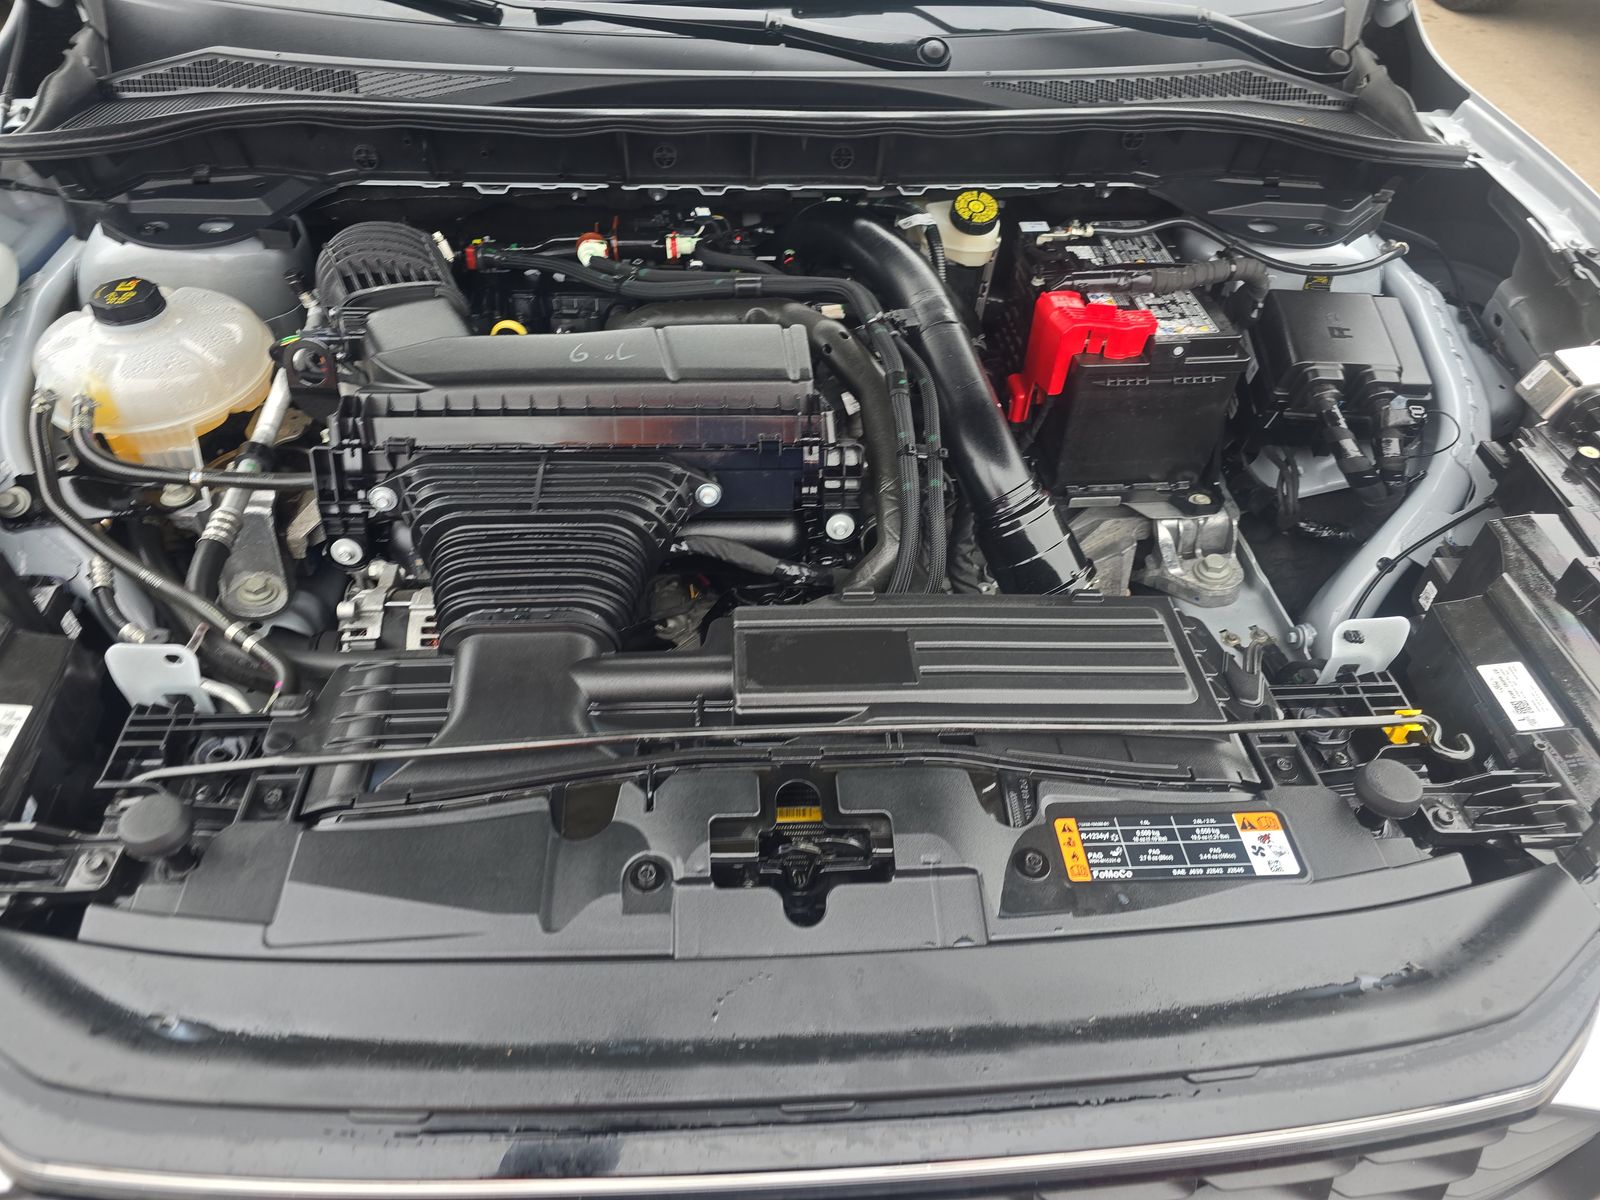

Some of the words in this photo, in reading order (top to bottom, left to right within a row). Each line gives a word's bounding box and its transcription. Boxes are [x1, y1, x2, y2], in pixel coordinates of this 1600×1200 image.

[1151, 829, 1160, 837] kg
[1211, 827, 1220, 835] kg
[1087, 851, 1103, 859] PAG
[1092, 869, 1133, 879] FoMoCo
